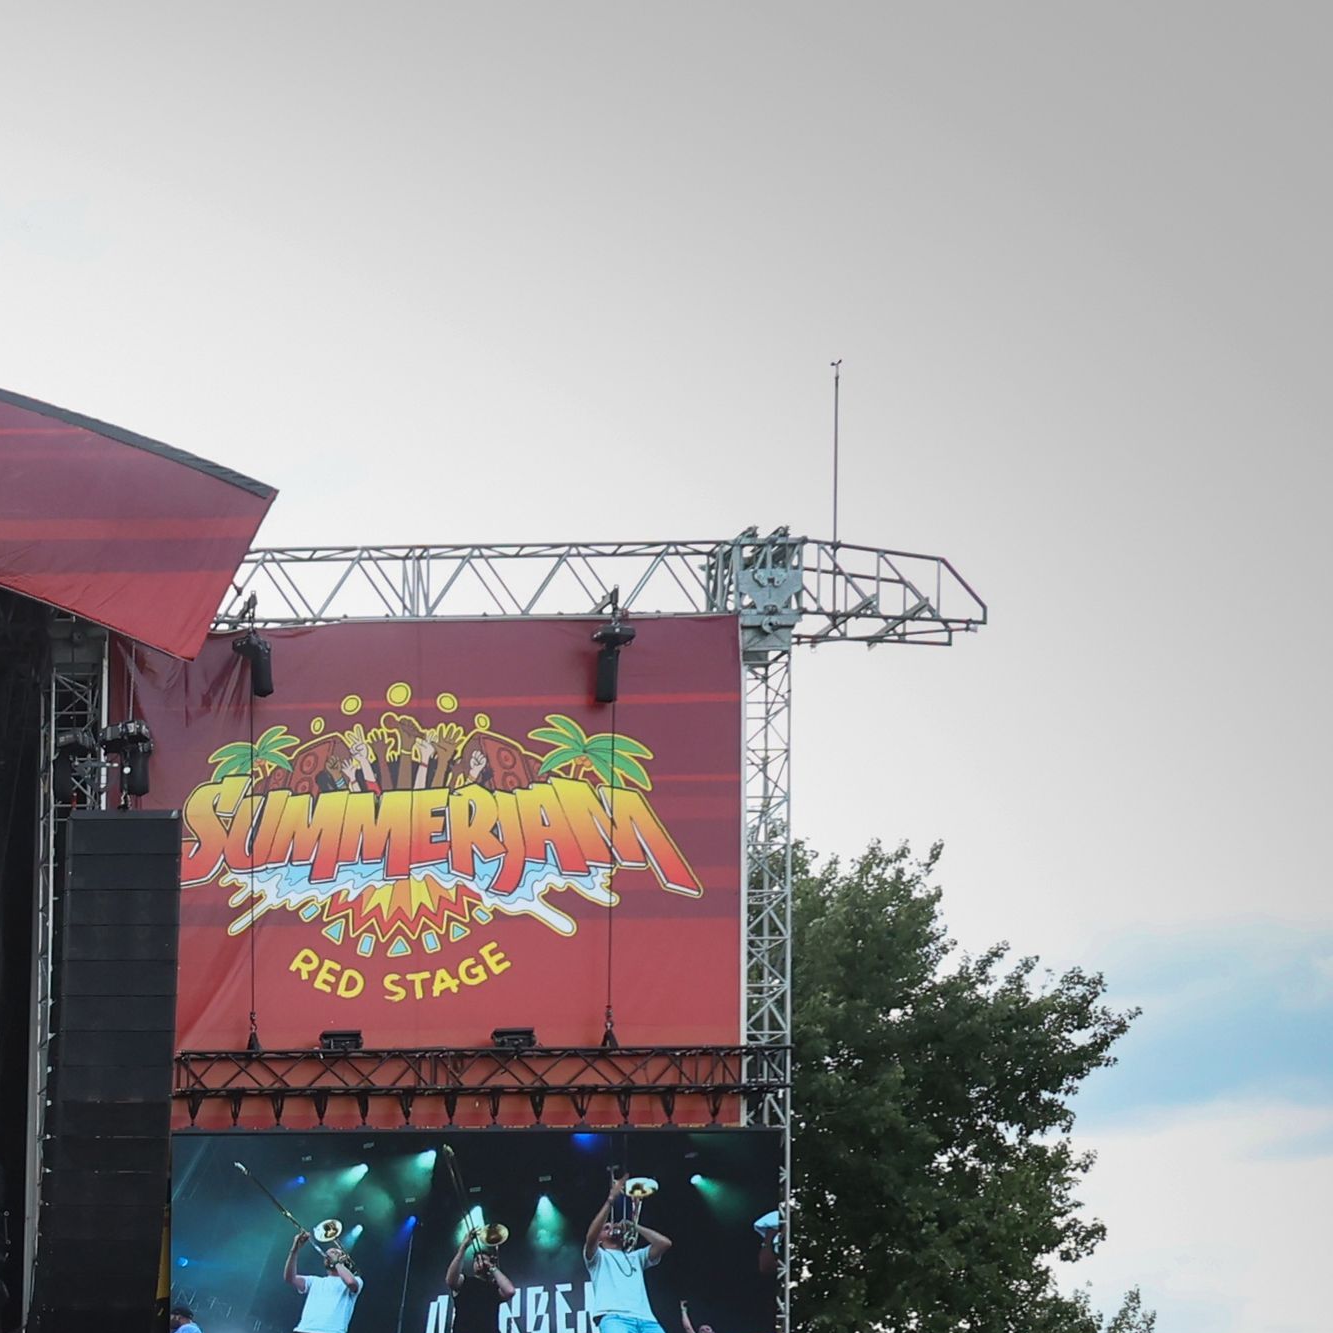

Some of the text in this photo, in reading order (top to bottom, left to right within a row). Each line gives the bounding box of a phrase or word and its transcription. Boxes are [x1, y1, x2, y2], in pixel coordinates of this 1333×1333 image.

[180, 776, 703, 897] SUMMERJAM
[289, 942, 511, 1002] RED STAGE
